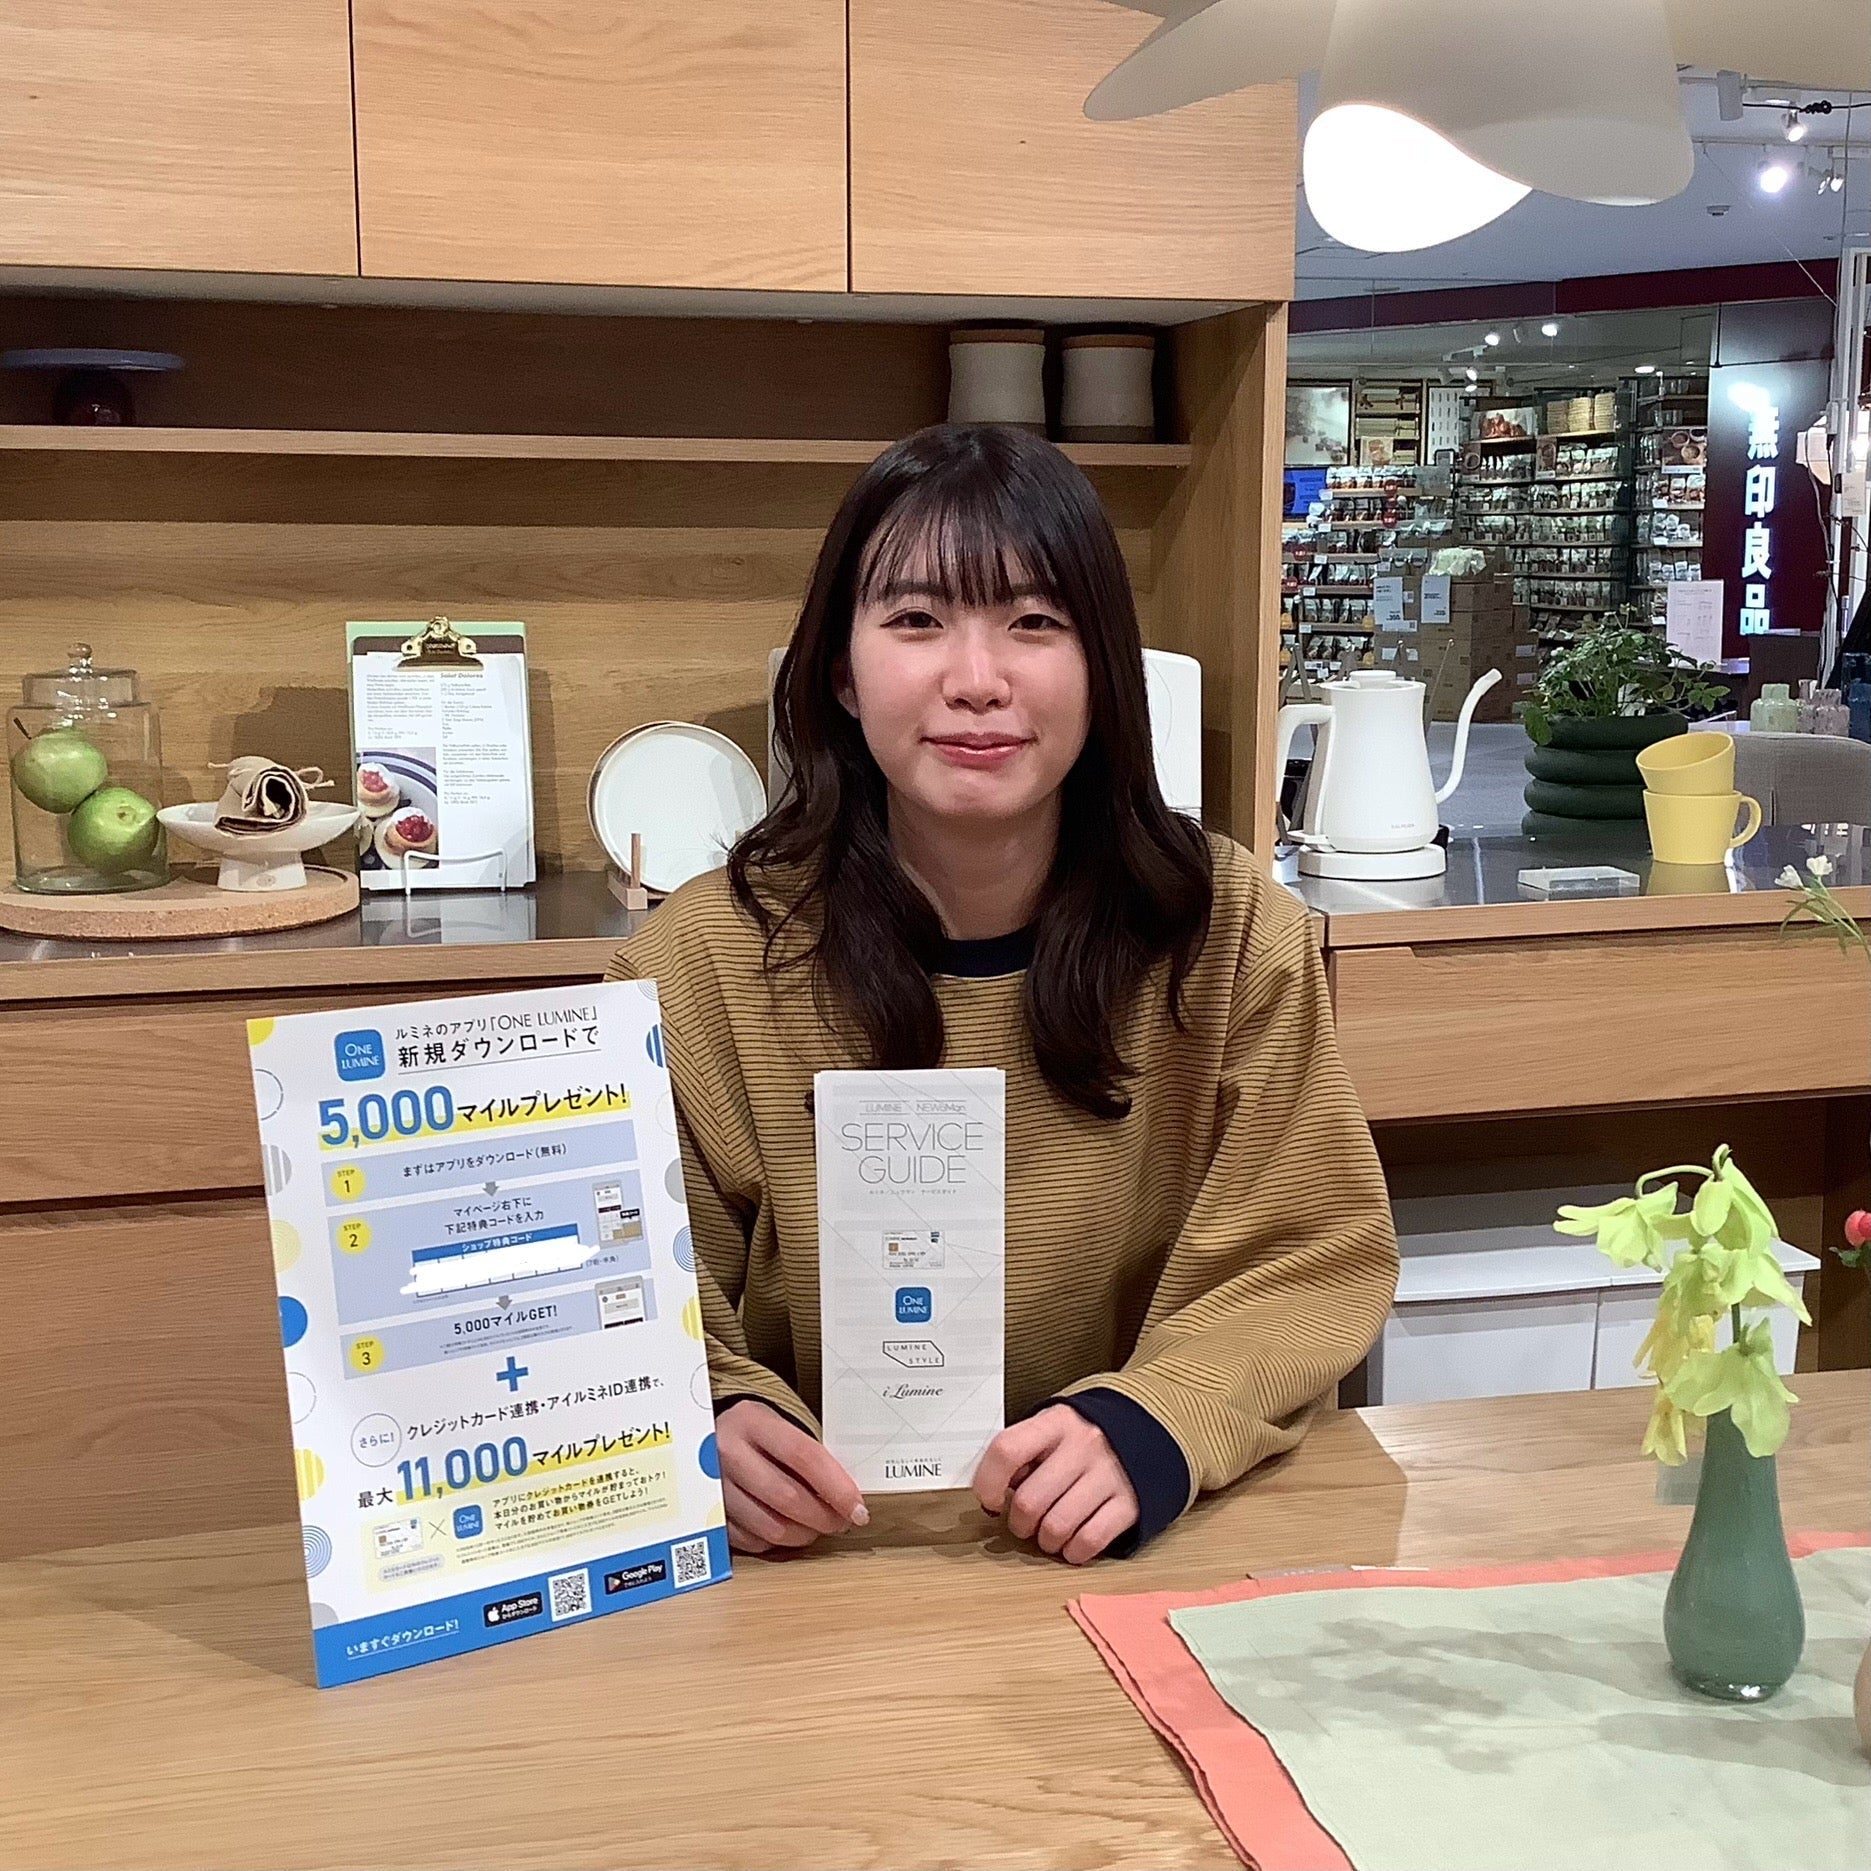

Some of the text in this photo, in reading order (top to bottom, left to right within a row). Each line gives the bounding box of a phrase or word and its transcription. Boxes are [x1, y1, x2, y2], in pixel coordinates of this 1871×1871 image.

[396, 1006, 598, 1040] ルミネのアプリ「ONE LUMINE」
[344, 1043, 373, 1057] ONE
[398, 1025, 600, 1068] 新規ダウンロードで
[341, 1055, 380, 1070] LUMINE
[841, 1122, 984, 1151] SERVICE
[337, 1169, 355, 1178] STEP
[858, 1155, 967, 1184] GUIDE
[344, 1180, 351, 1194] 1
[454, 1197, 532, 1217] マイページ右下に
[343, 1223, 362, 1232] STEP
[444, 1211, 544, 1236] 下記特典コードを入力
[349, 1234, 358, 1248] 2
[461, 1233, 533, 1252] ショップ特典コード
[902, 1295, 924, 1306] ONE
[899, 1306, 928, 1314] LUMINE
[453, 1305, 558, 1335] 5,000マイルGET!
[362, 1352, 371, 1366] 3
[890, 1383, 944, 1399] Lumine
[359, 1432, 394, 1449] さらに!
[885, 1463, 942, 1478] LUMINE
[622, 1564, 663, 1582] Google Play
[501, 1597, 539, 1615] App Store
[347, 1619, 459, 1653] いますぐダウンロード!
